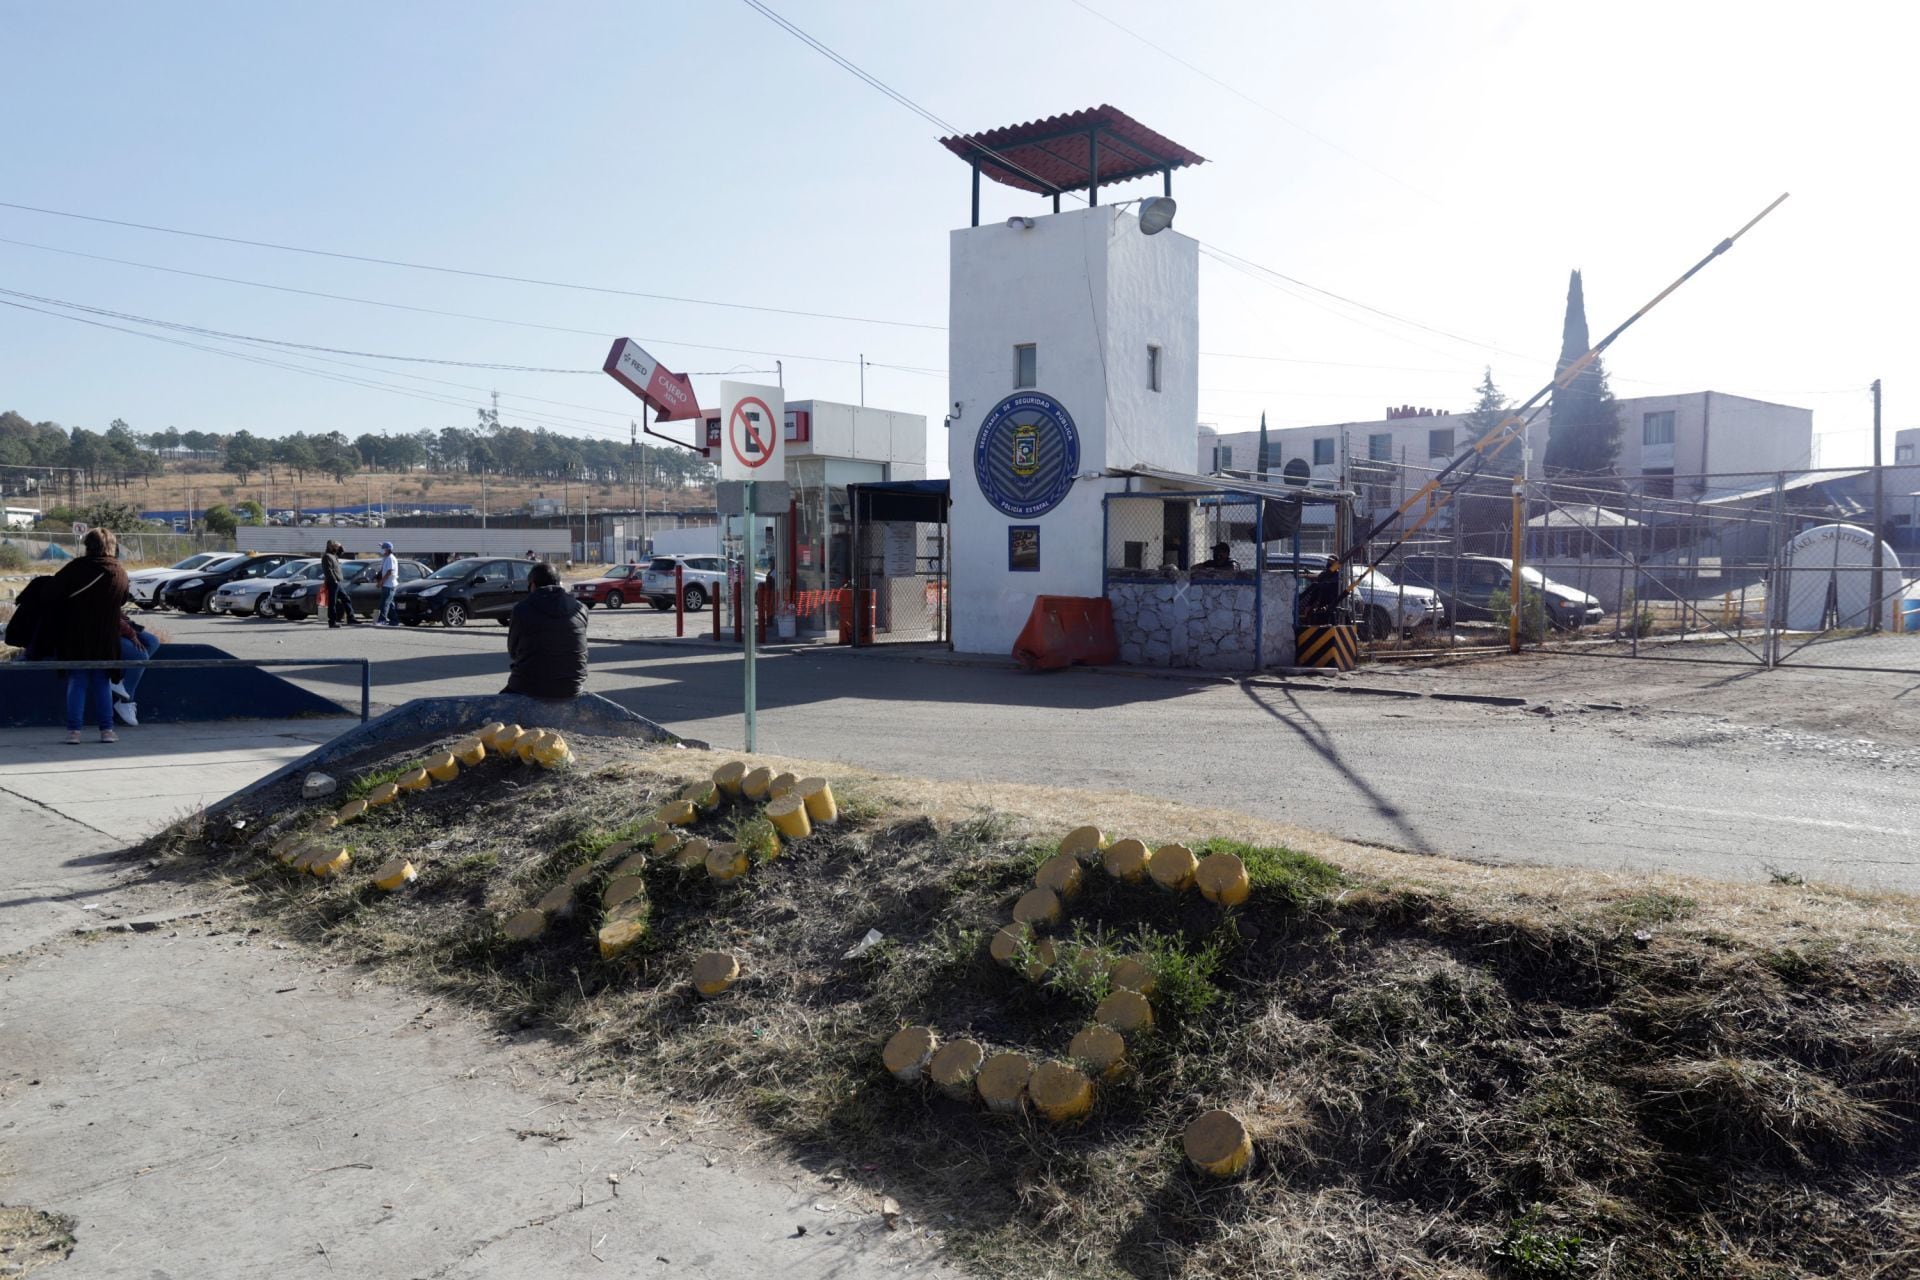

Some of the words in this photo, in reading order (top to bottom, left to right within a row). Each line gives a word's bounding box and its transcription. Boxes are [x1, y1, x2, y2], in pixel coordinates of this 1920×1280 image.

[631, 361, 648, 376] RED
[658, 375, 688, 402] CAJERO
[1002, 403, 1011, 412] DE
[1014, 397, 1050, 409] SEGURIDAD
[1025, 500, 1049, 513] ESTATAL
